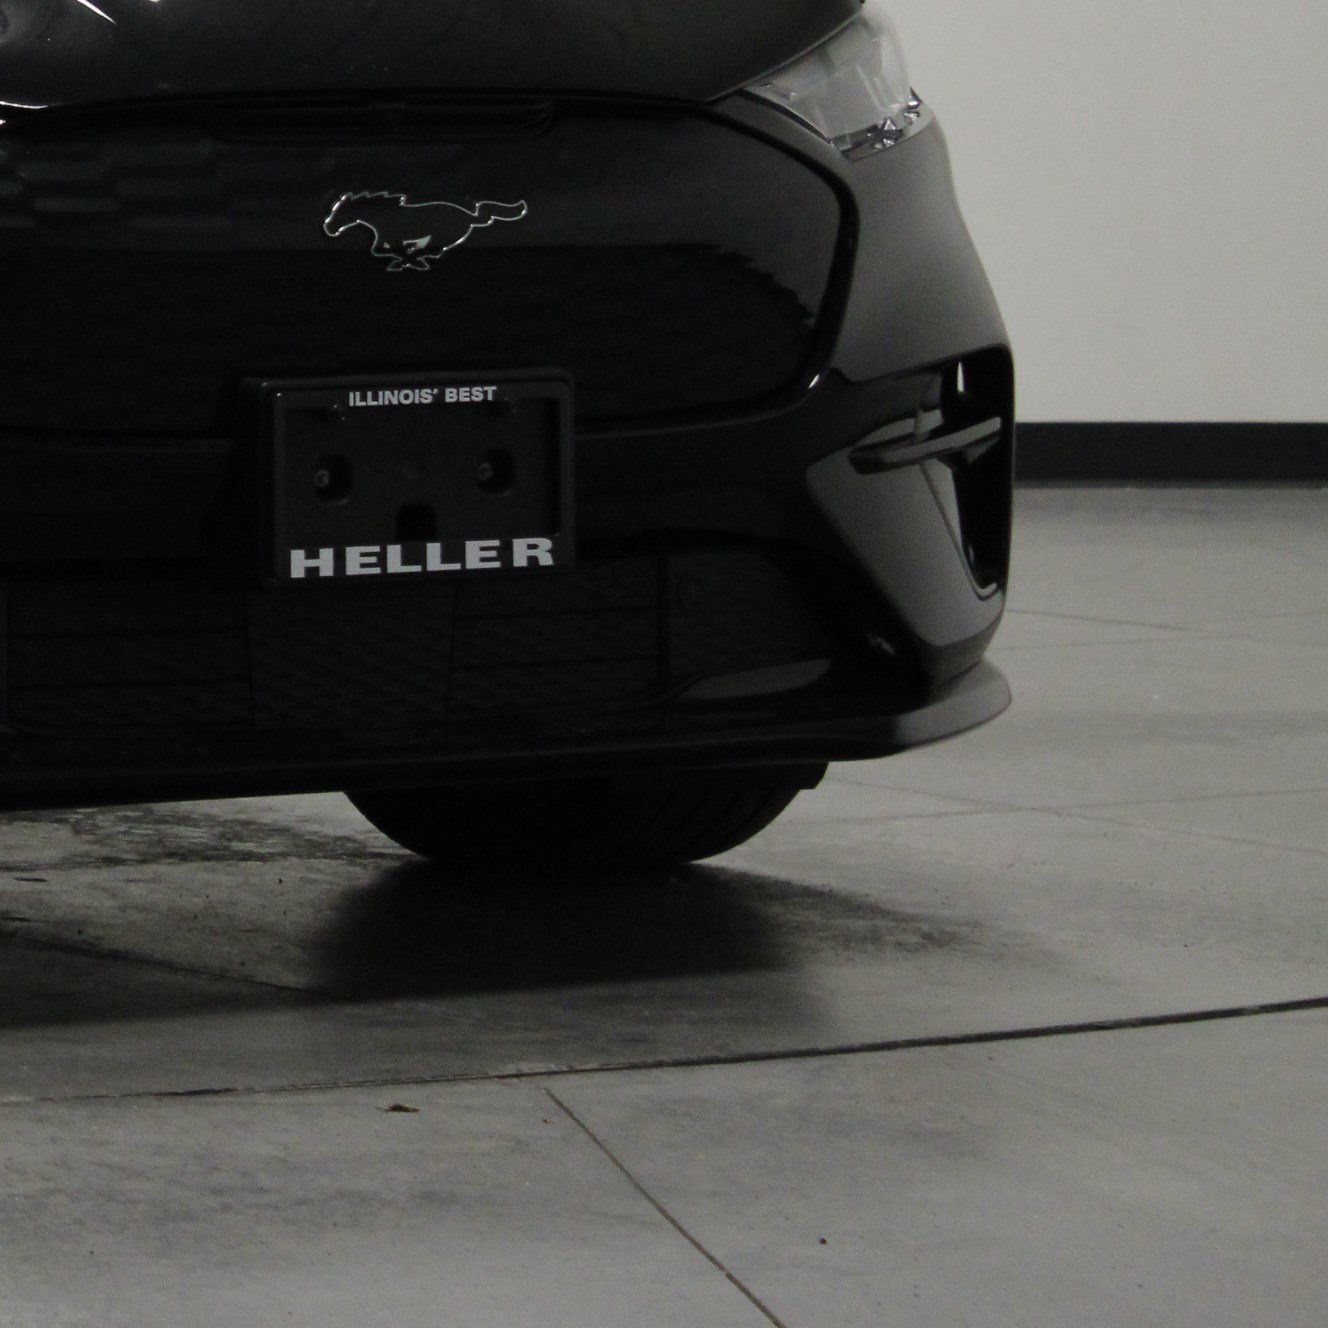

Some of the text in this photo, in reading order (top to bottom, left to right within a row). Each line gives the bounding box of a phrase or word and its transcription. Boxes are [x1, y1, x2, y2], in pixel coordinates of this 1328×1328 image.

[348, 386, 498, 407] ILLINOIS' BEST
[290, 537, 555, 579] HELLER
